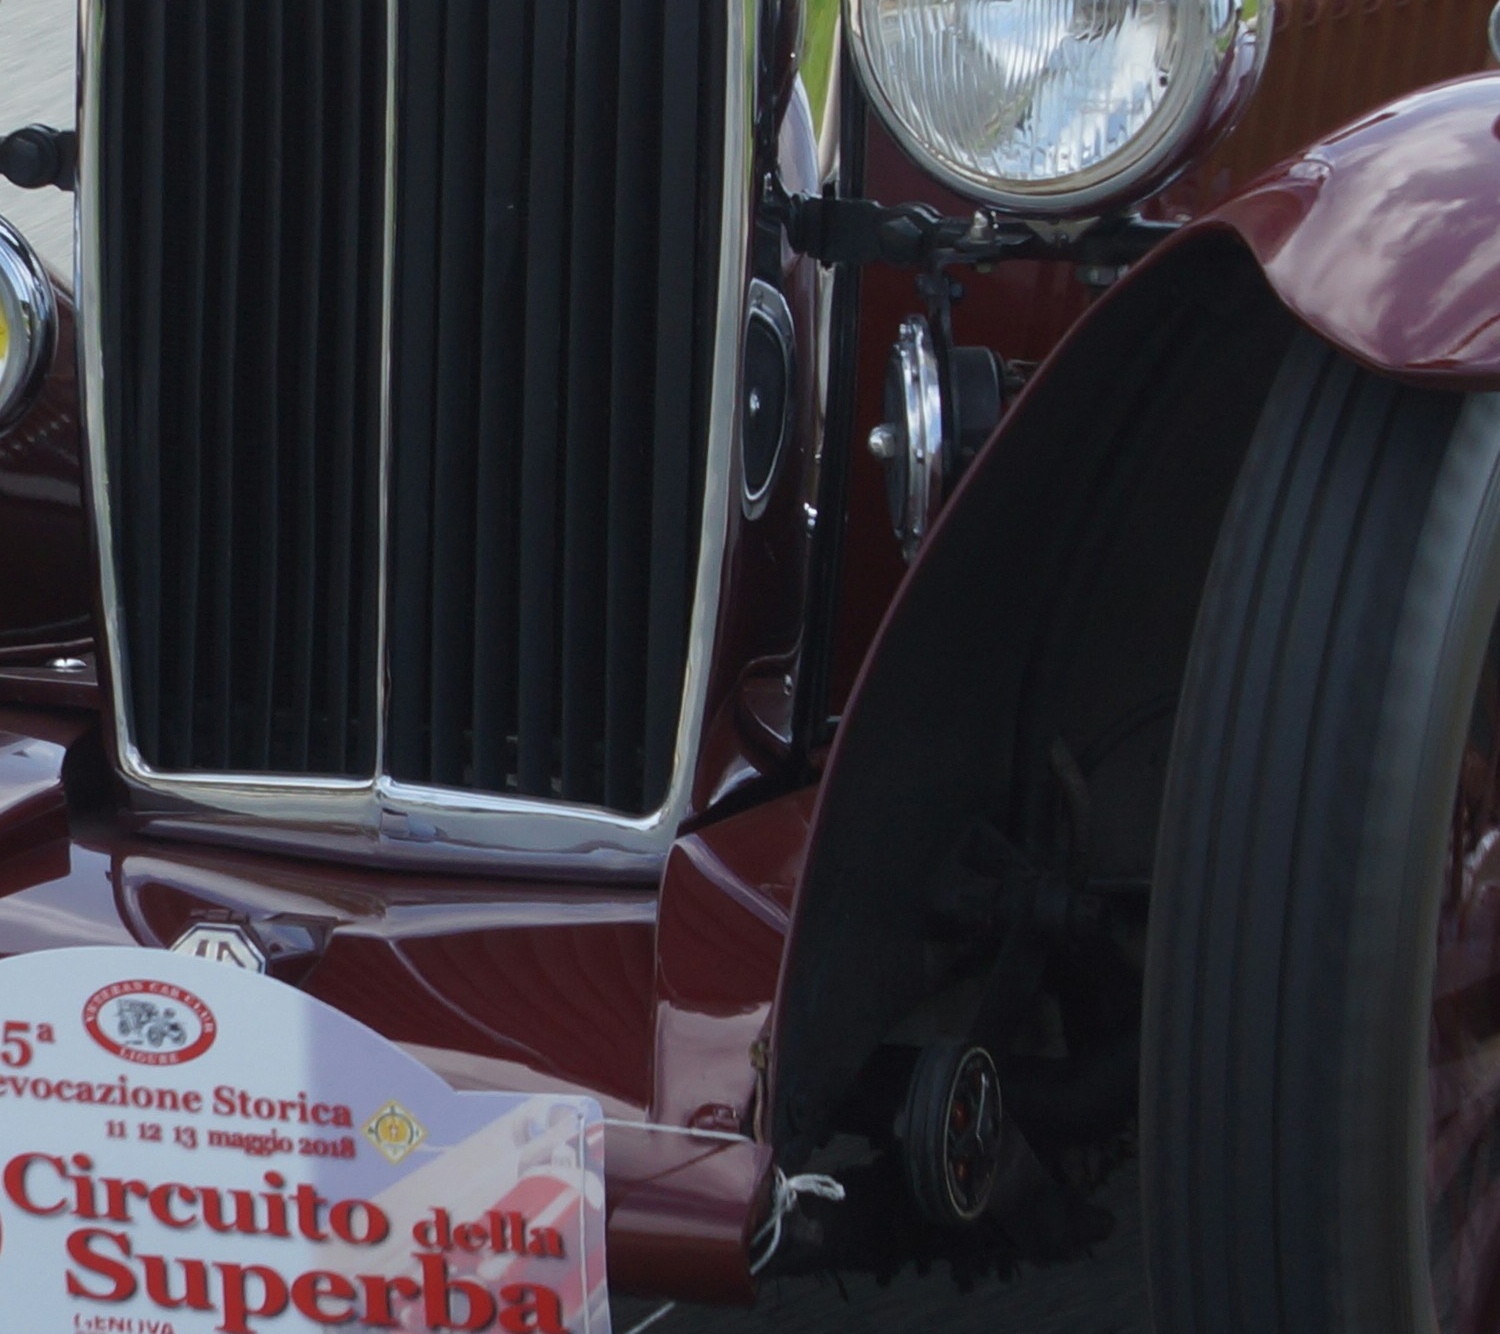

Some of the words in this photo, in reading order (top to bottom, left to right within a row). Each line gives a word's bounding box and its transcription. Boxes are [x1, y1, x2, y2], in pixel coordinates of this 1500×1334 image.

[212, 1084, 353, 1129] Storica
[106, 1119, 127, 1138] 11
[137, 1123, 161, 1142] 12
[172, 1126, 197, 1149] 13
[208, 1130, 293, 1156] maggio
[298, 1136, 356, 1159] 2018
[3, 1151, 391, 1245] Circuito
[412, 1206, 565, 1258] della
